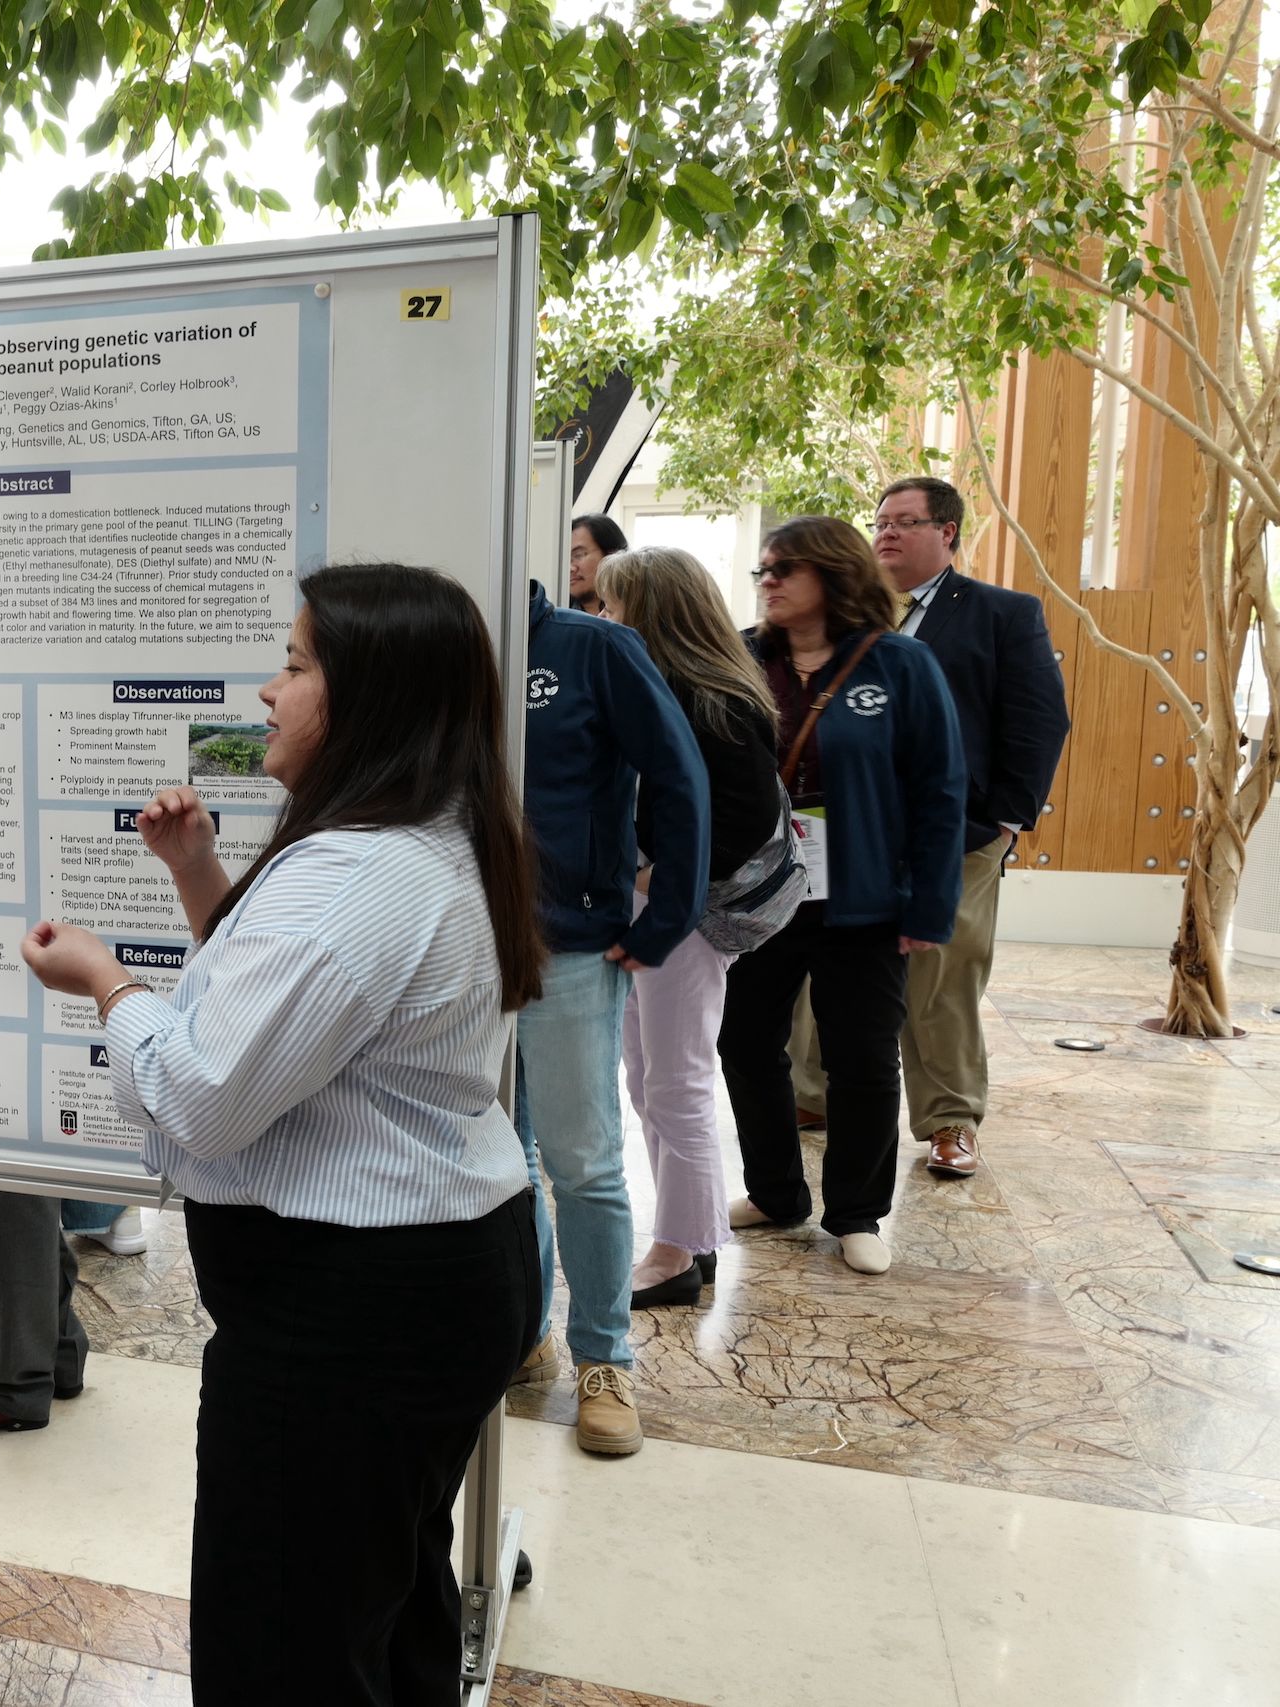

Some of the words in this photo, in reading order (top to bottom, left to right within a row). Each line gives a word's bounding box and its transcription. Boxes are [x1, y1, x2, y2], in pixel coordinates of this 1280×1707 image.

[408, 295, 442, 318] 27
[85, 330, 148, 352] genetic
[154, 325, 232, 343] variation
[238, 321, 257, 338] of
[59, 352, 161, 375] populations
[60, 385, 91, 400] Walid
[140, 381, 176, 394] Corley
[13, 400, 47, 416] Peggy
[18, 422, 65, 434] Genetics
[67, 420, 88, 432] and
[91, 418, 149, 430] Genomics,
[152, 415, 187, 427] Tifton,
[190, 413, 212, 425] GA,
[215, 412, 236, 425] US;
[11, 435, 65, 448] Huntsville,
[68, 434, 86, 446] AL,
[89, 433, 109, 445] US;
[113, 429, 179, 443] USDA-ARS,
[183, 428, 214, 440] Tifton
[217, 426, 239, 439] GA,
[243, 425, 261, 437] US
[2, 512, 28, 522] owing
[30, 511, 39, 520] to
[49, 509, 111, 519] domestication
[113, 506, 162, 517] bottleneck.
[166, 505, 203, 515] Induced
[205, 504, 252, 514] mutations
[254, 502, 291, 514] through
[527, 668, 558, 682] GREDIENT
[115, 685, 222, 699] Observations
[527, 698, 550, 709] IENCE
[2, 712, 21, 721] crop
[60, 711, 74, 720] M3
[76, 711, 97, 720] lines
[98, 712, 130, 722] display
[132, 711, 191, 721] Tifrunner-like
[194, 712, 242, 723] phenotype
[70, 726, 113, 738] Spreading
[114, 727, 144, 738] growth
[146, 727, 167, 736] habit
[70, 741, 113, 751] Prominent
[114, 742, 157, 751] Mainstem
[70, 756, 83, 765] No
[84, 757, 125, 766] mainstem
[127, 757, 166, 768] flowering
[61, 857, 82, 865] seed
[84, 857, 101, 866] NIR
[103, 858, 134, 869] profile)
[123, 949, 185, 965] Referen
[61, 1002, 95, 1013] Clevenger
[61, 1011, 97, 1021] Signatures
[59, 1079, 86, 1088] Georgia
[83, 1114, 113, 1123] Institute
[115, 1116, 122, 1124] of
[83, 1137, 117, 1146] UNIVERSITY
[119, 1139, 128, 1147] OF
